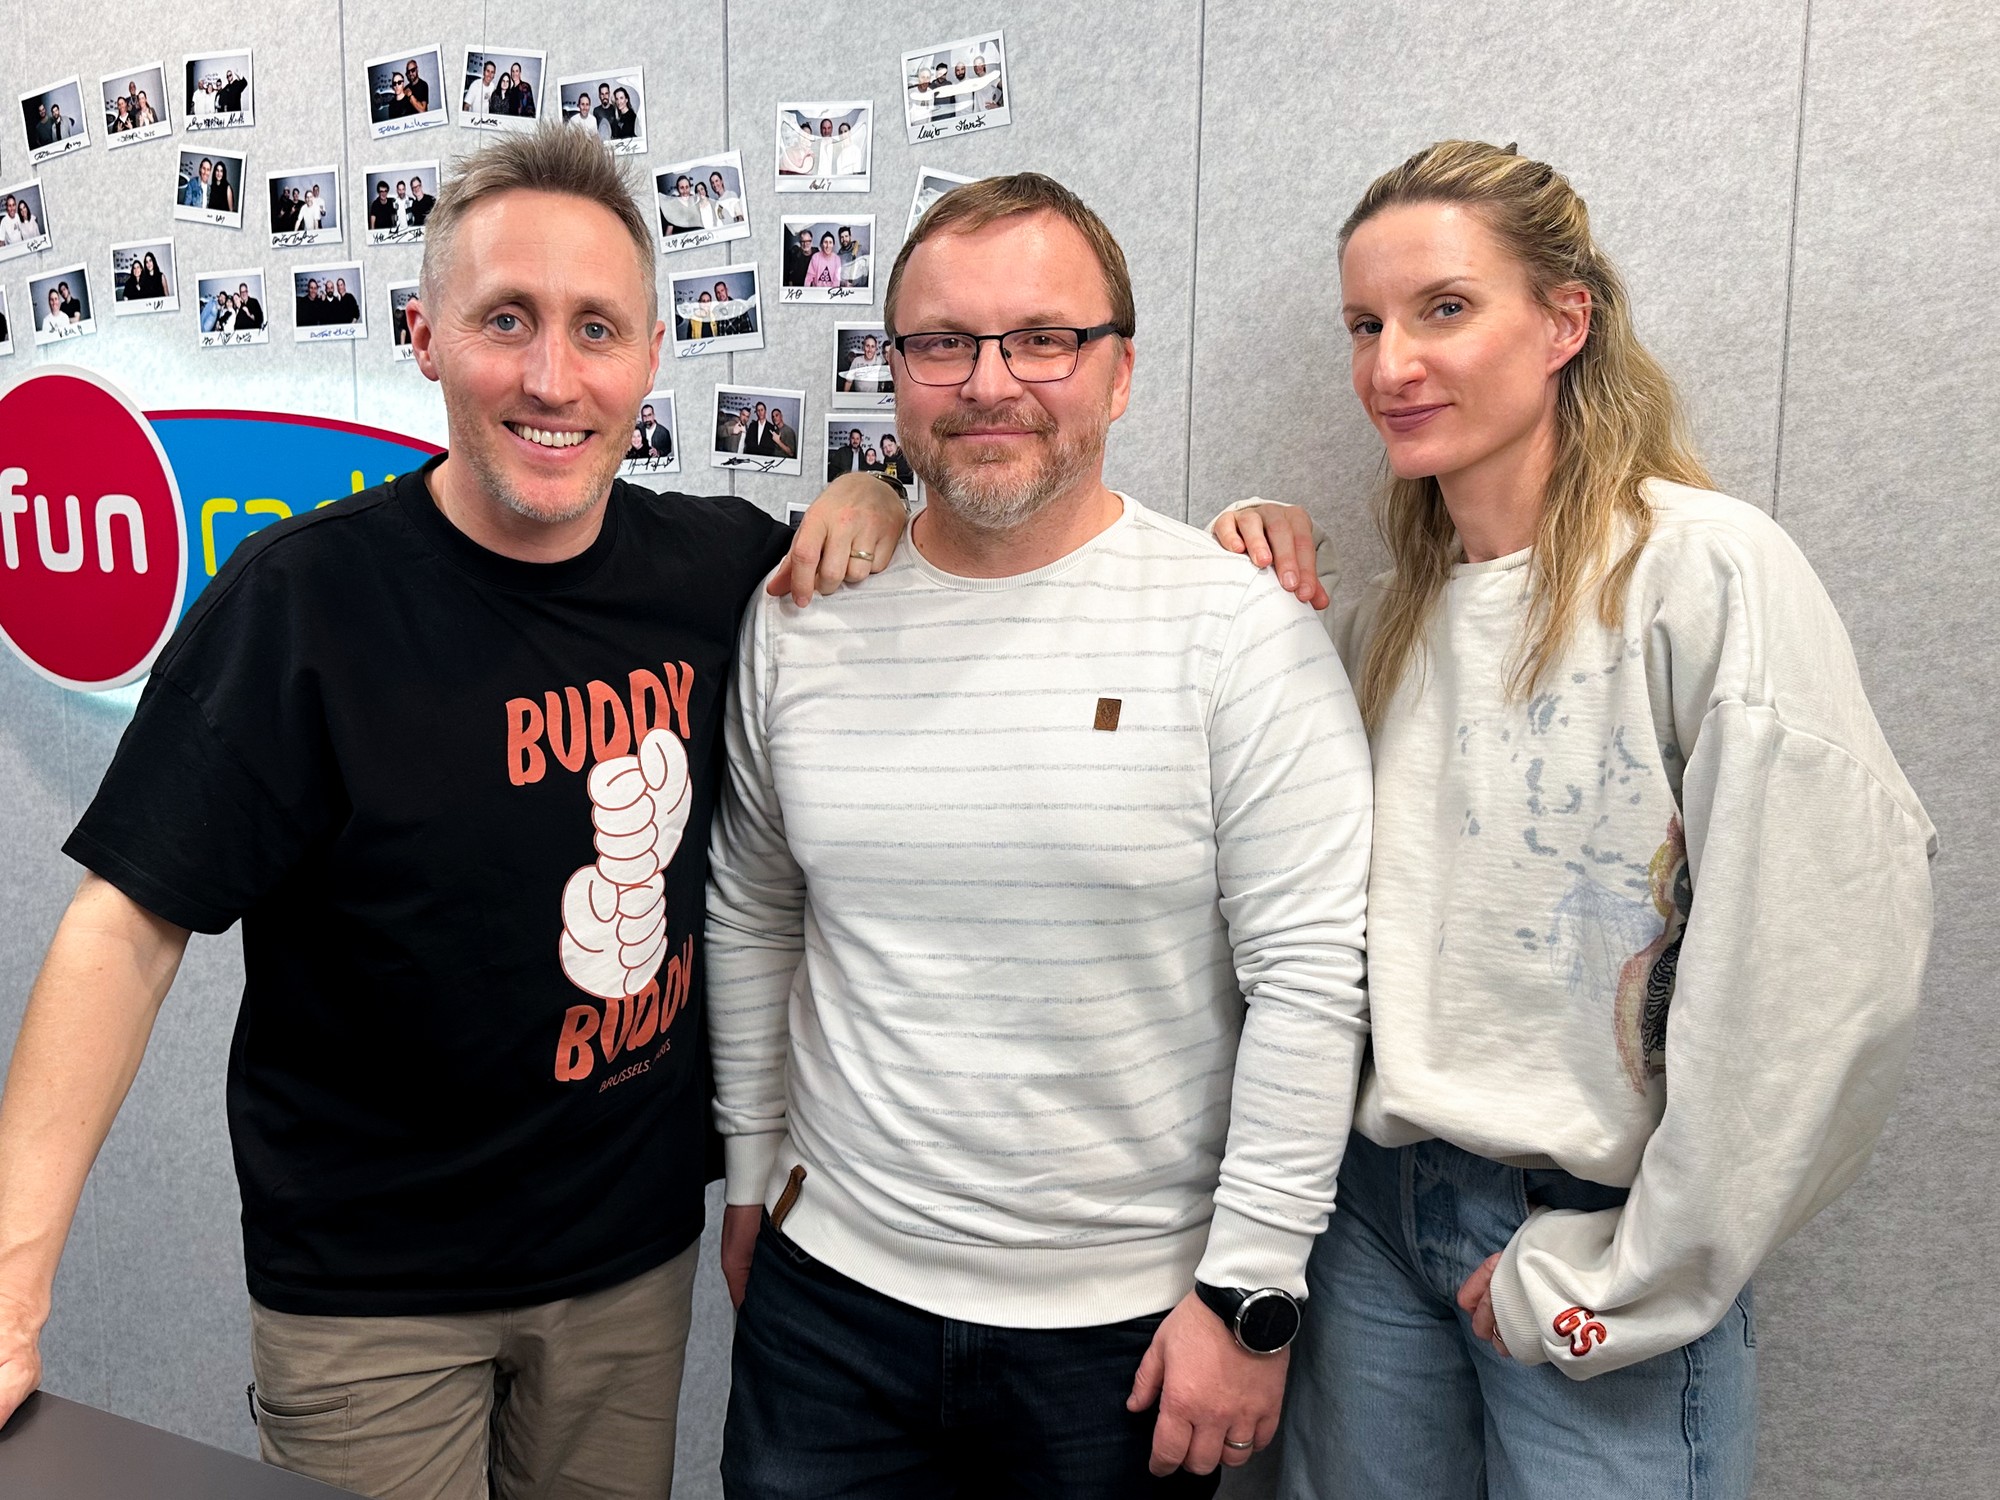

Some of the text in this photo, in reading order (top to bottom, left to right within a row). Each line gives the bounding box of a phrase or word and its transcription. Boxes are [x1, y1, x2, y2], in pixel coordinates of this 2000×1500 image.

[0, 467, 148, 574] fun
[505, 660, 695, 786] BUDDY
[555, 933, 694, 1082] BUDDY
